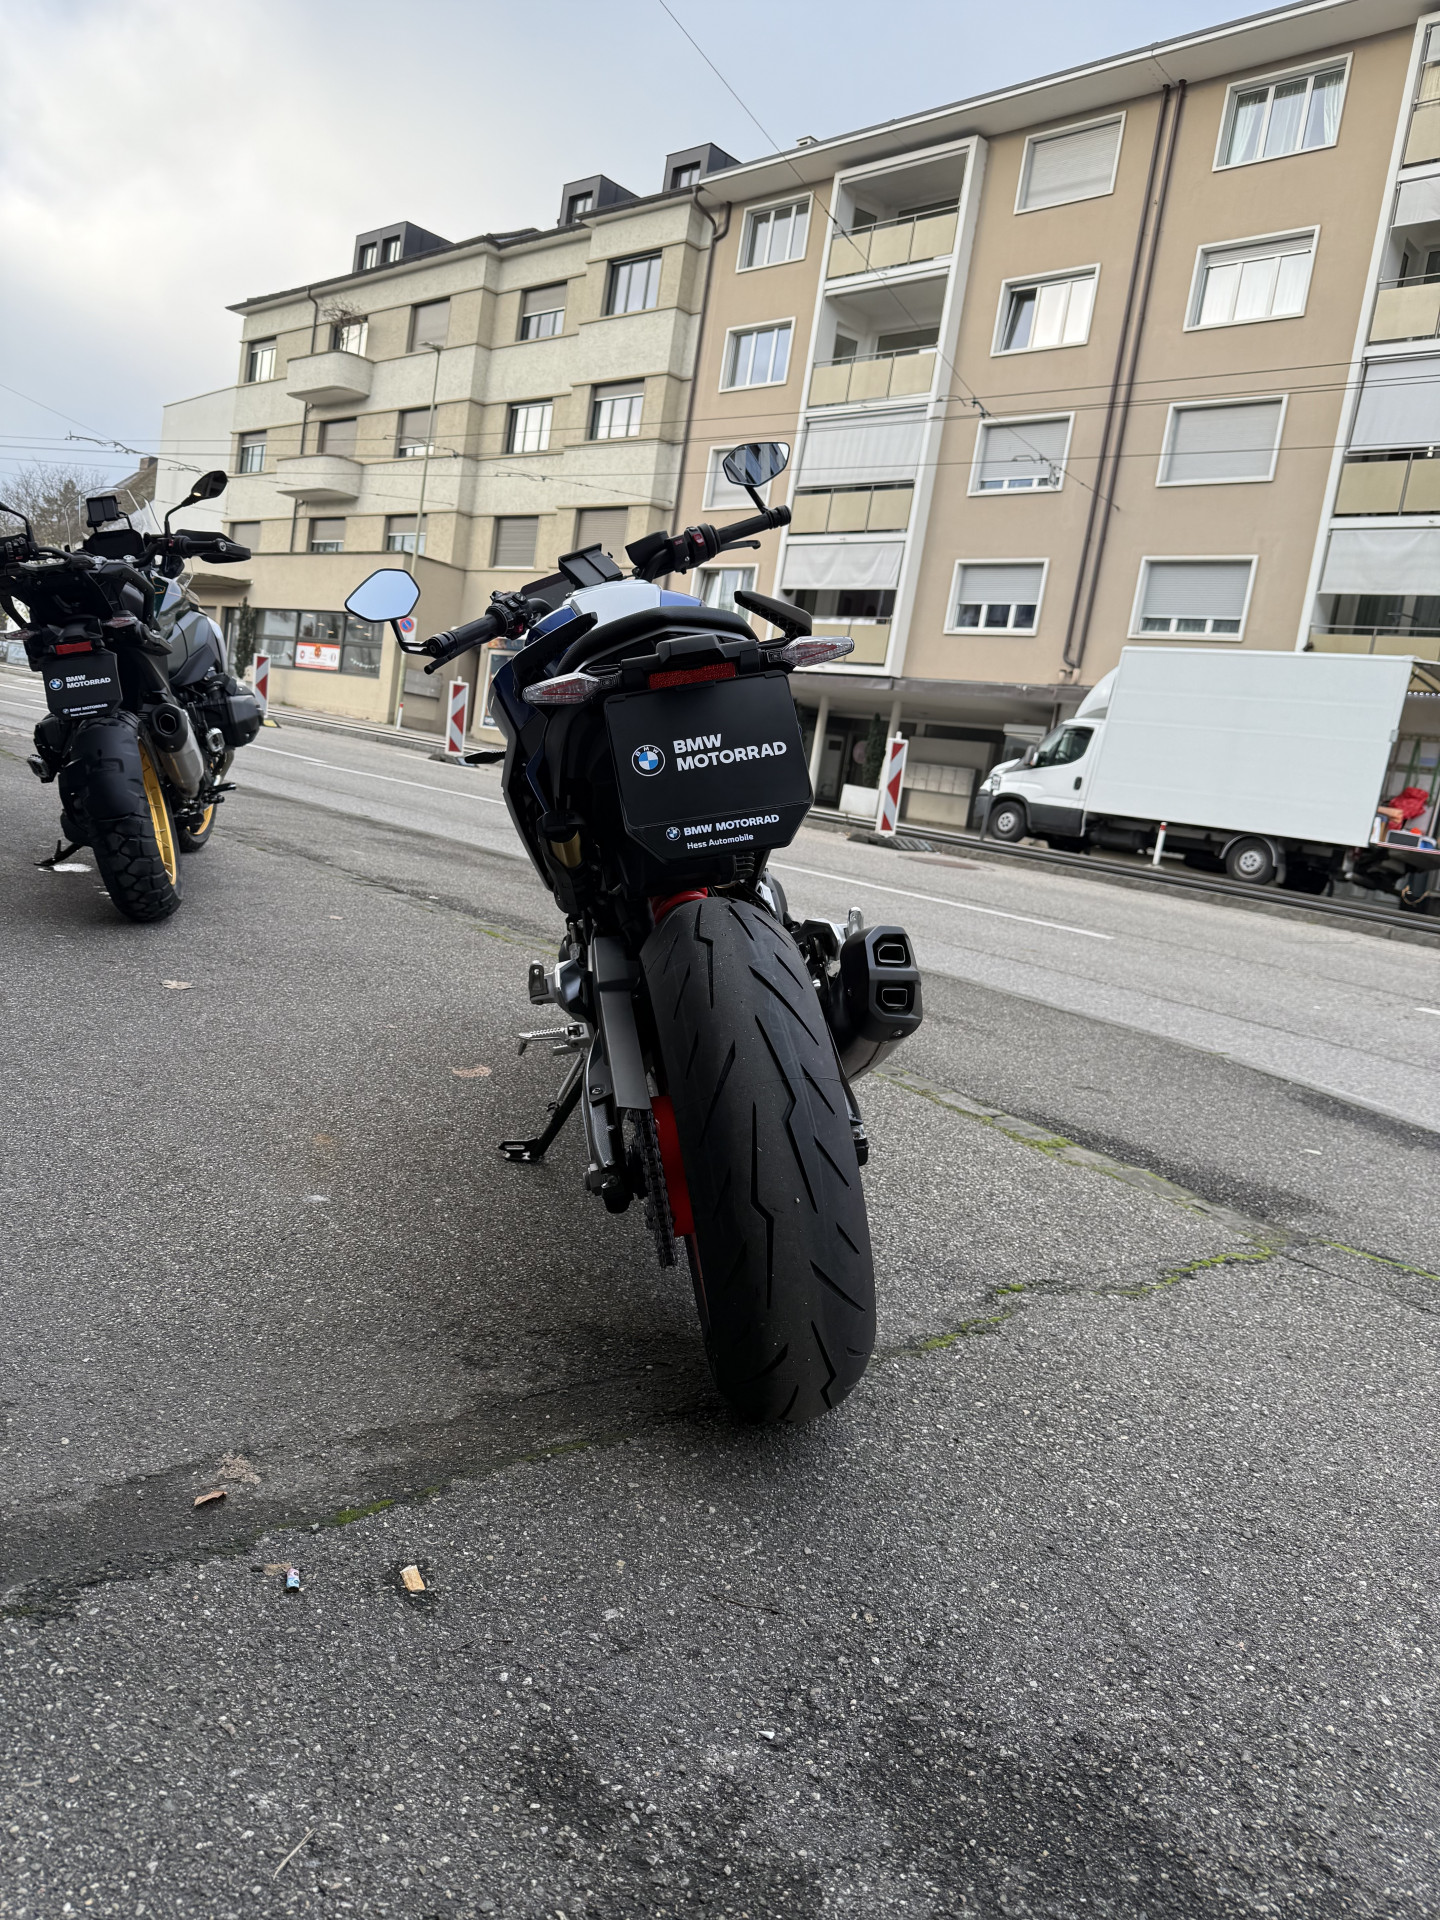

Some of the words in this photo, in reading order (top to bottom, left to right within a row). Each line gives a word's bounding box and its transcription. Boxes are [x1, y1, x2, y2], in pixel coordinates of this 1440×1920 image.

[67, 677, 111, 688] MOTORRAD
[673, 733, 722, 754] BMW
[676, 741, 787, 772] MOTORRAD
[683, 824, 713, 837] BMW
[716, 814, 779, 831] MOTORRAD
[686, 842, 707, 850] Hess
[708, 834, 754, 847] Automobile
